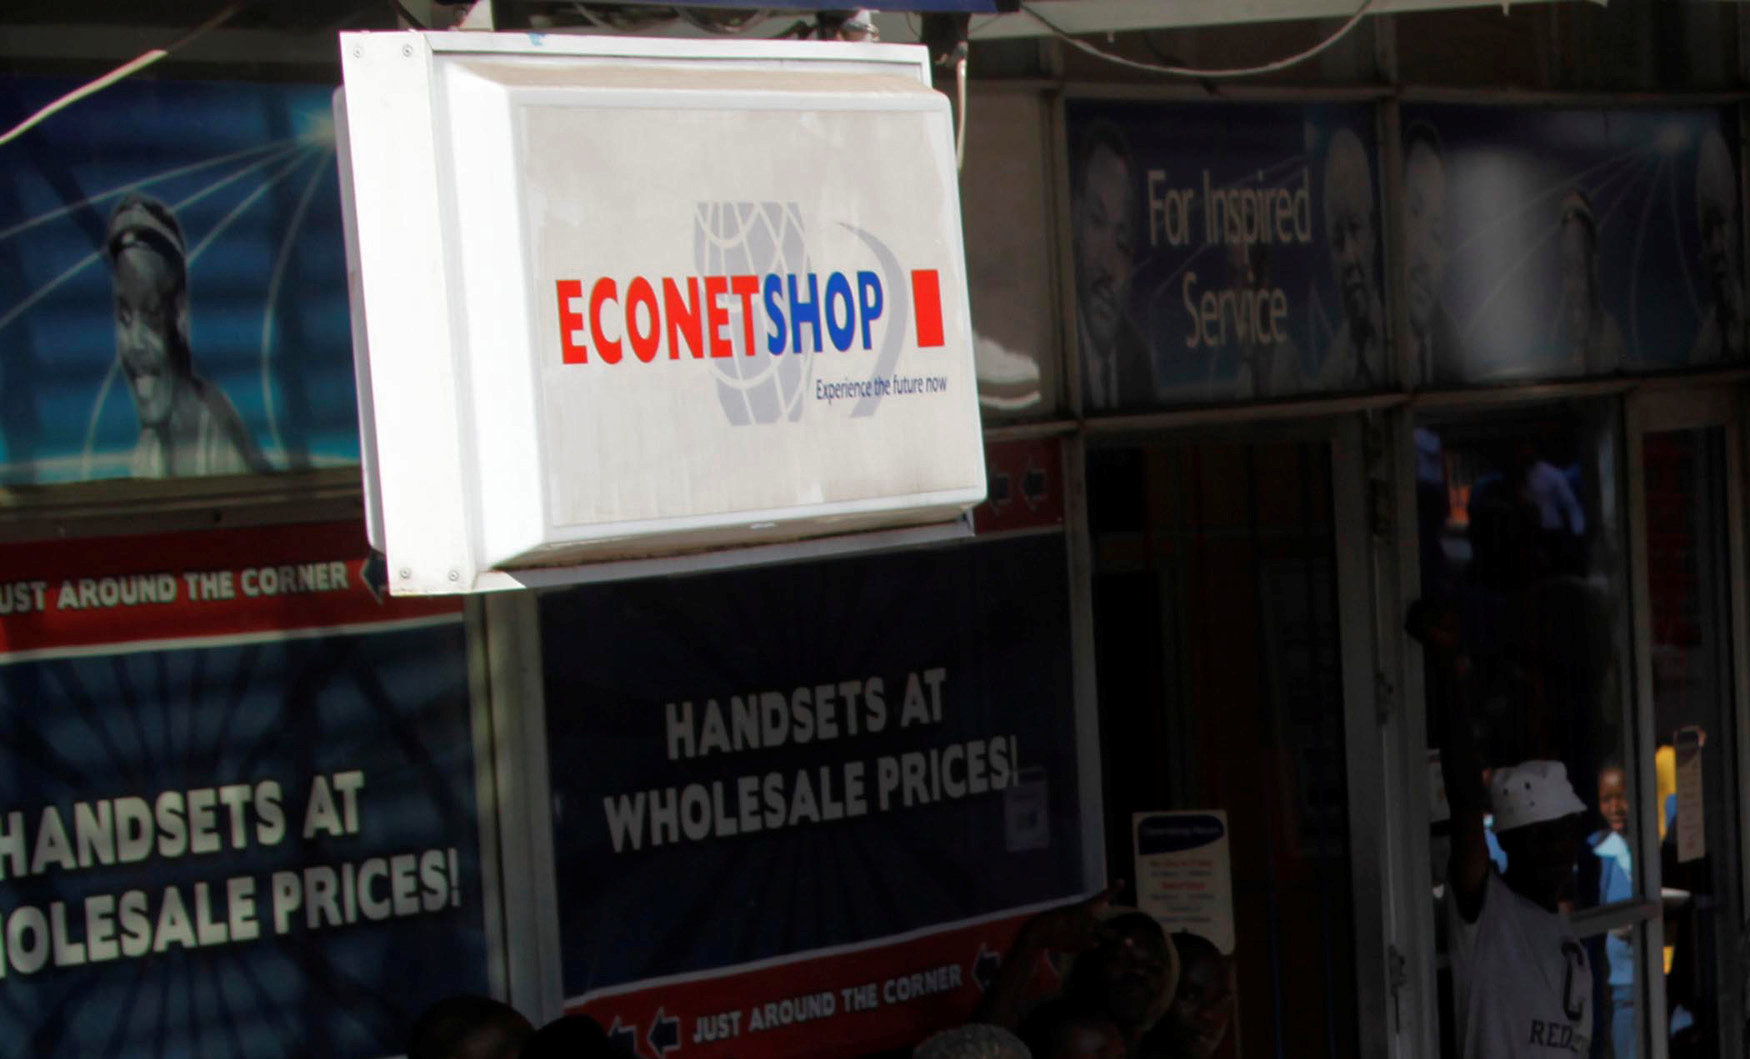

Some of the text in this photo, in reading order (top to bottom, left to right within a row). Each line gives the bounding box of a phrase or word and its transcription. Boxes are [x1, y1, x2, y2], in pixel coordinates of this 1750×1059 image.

[1147, 165, 1312, 264] For Inspired
[556, 271, 884, 365] ECONETSHOP
[1181, 271, 1288, 348] Service
[816, 374, 947, 405] Experience the future now
[0, 561, 349, 615] UST AROUND THE CORNER
[664, 666, 947, 762] HANDSETS AT
[303, 769, 365, 840] AT
[602, 734, 1020, 855] WHOLESALE PRICES!
[0, 847, 462, 980] OLESALE PRICES!
[692, 963, 964, 1045] JUST AROUND THE CORNER
